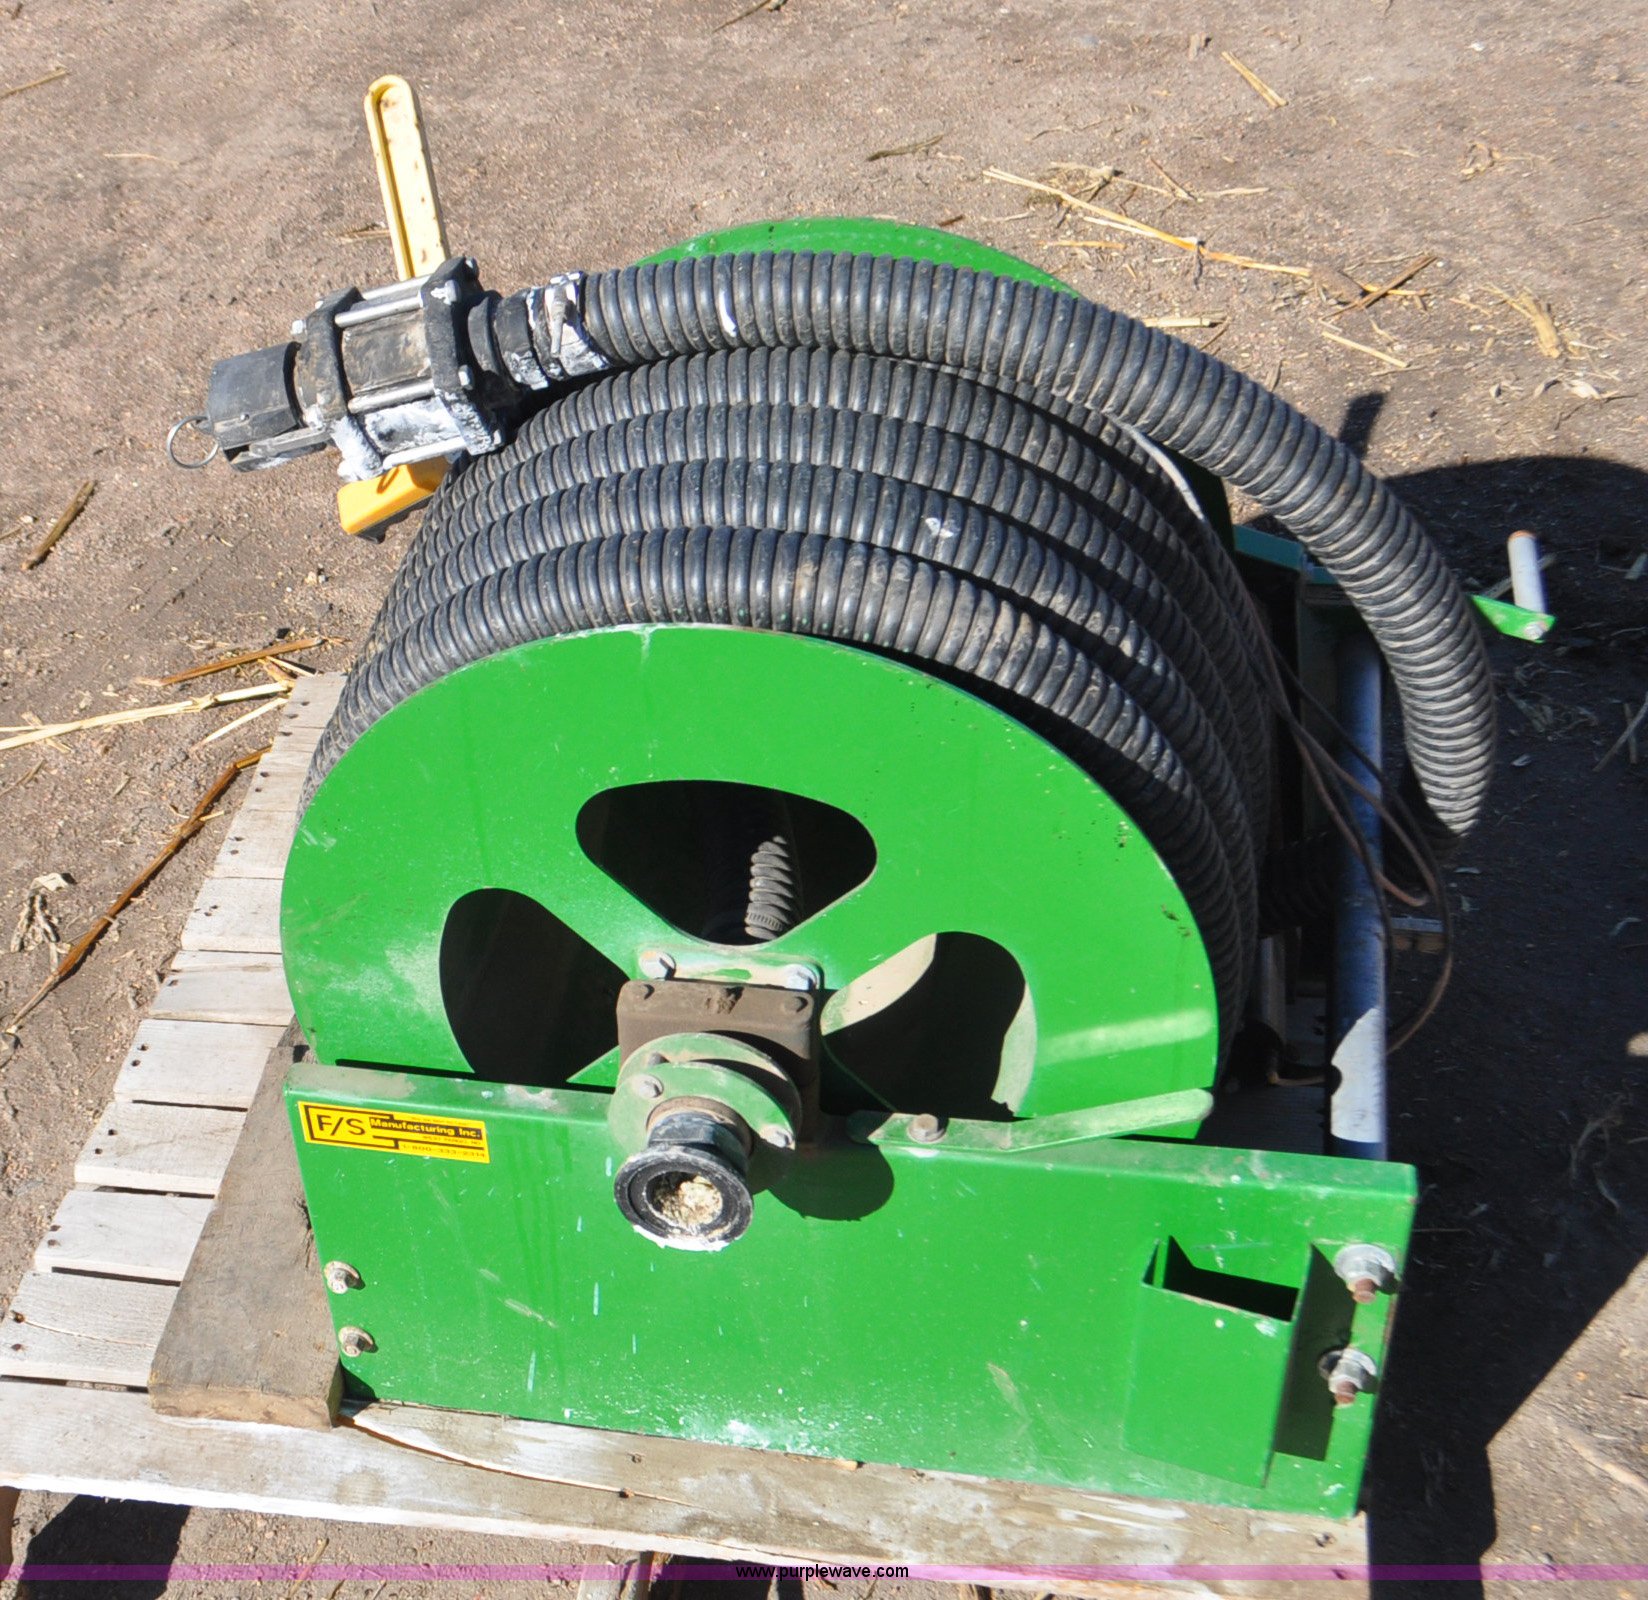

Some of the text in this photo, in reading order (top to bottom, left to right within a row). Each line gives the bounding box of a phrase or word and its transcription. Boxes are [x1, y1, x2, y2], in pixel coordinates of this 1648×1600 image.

[316, 1114, 366, 1136] F/S
[370, 1118, 455, 1136] Manufacturing
[458, 1128, 481, 1138] Inc.
